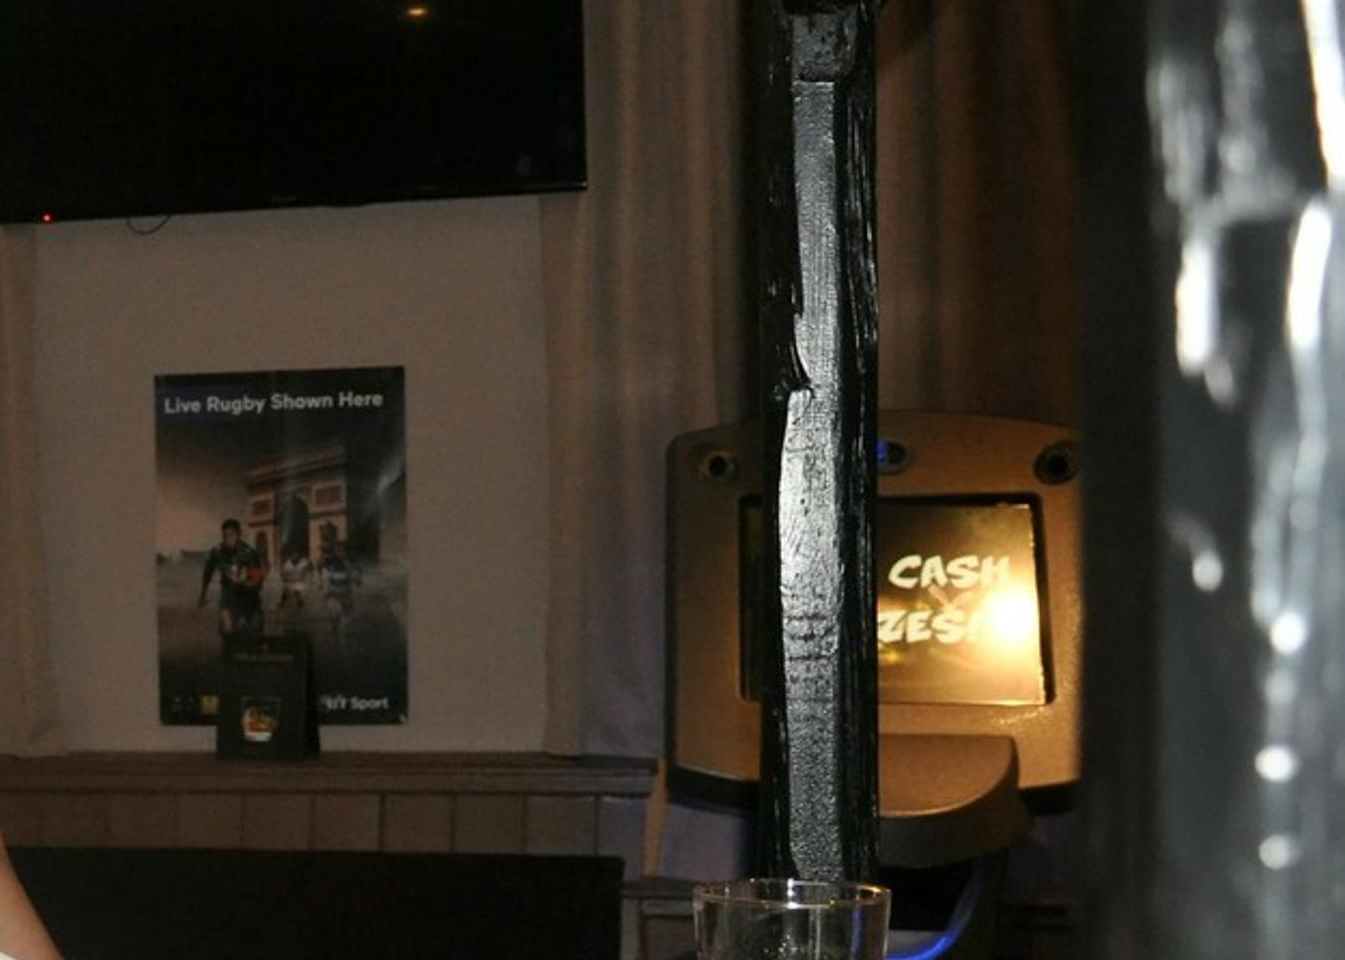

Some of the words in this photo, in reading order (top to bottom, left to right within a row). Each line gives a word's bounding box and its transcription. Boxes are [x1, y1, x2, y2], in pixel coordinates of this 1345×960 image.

[164, 397, 201, 414] Live
[206, 395, 266, 416] Rugby
[270, 393, 333, 411] Shown
[338, 391, 384, 407] Here
[888, 554, 1011, 589] CASH
[350, 696, 390, 712] Sport
